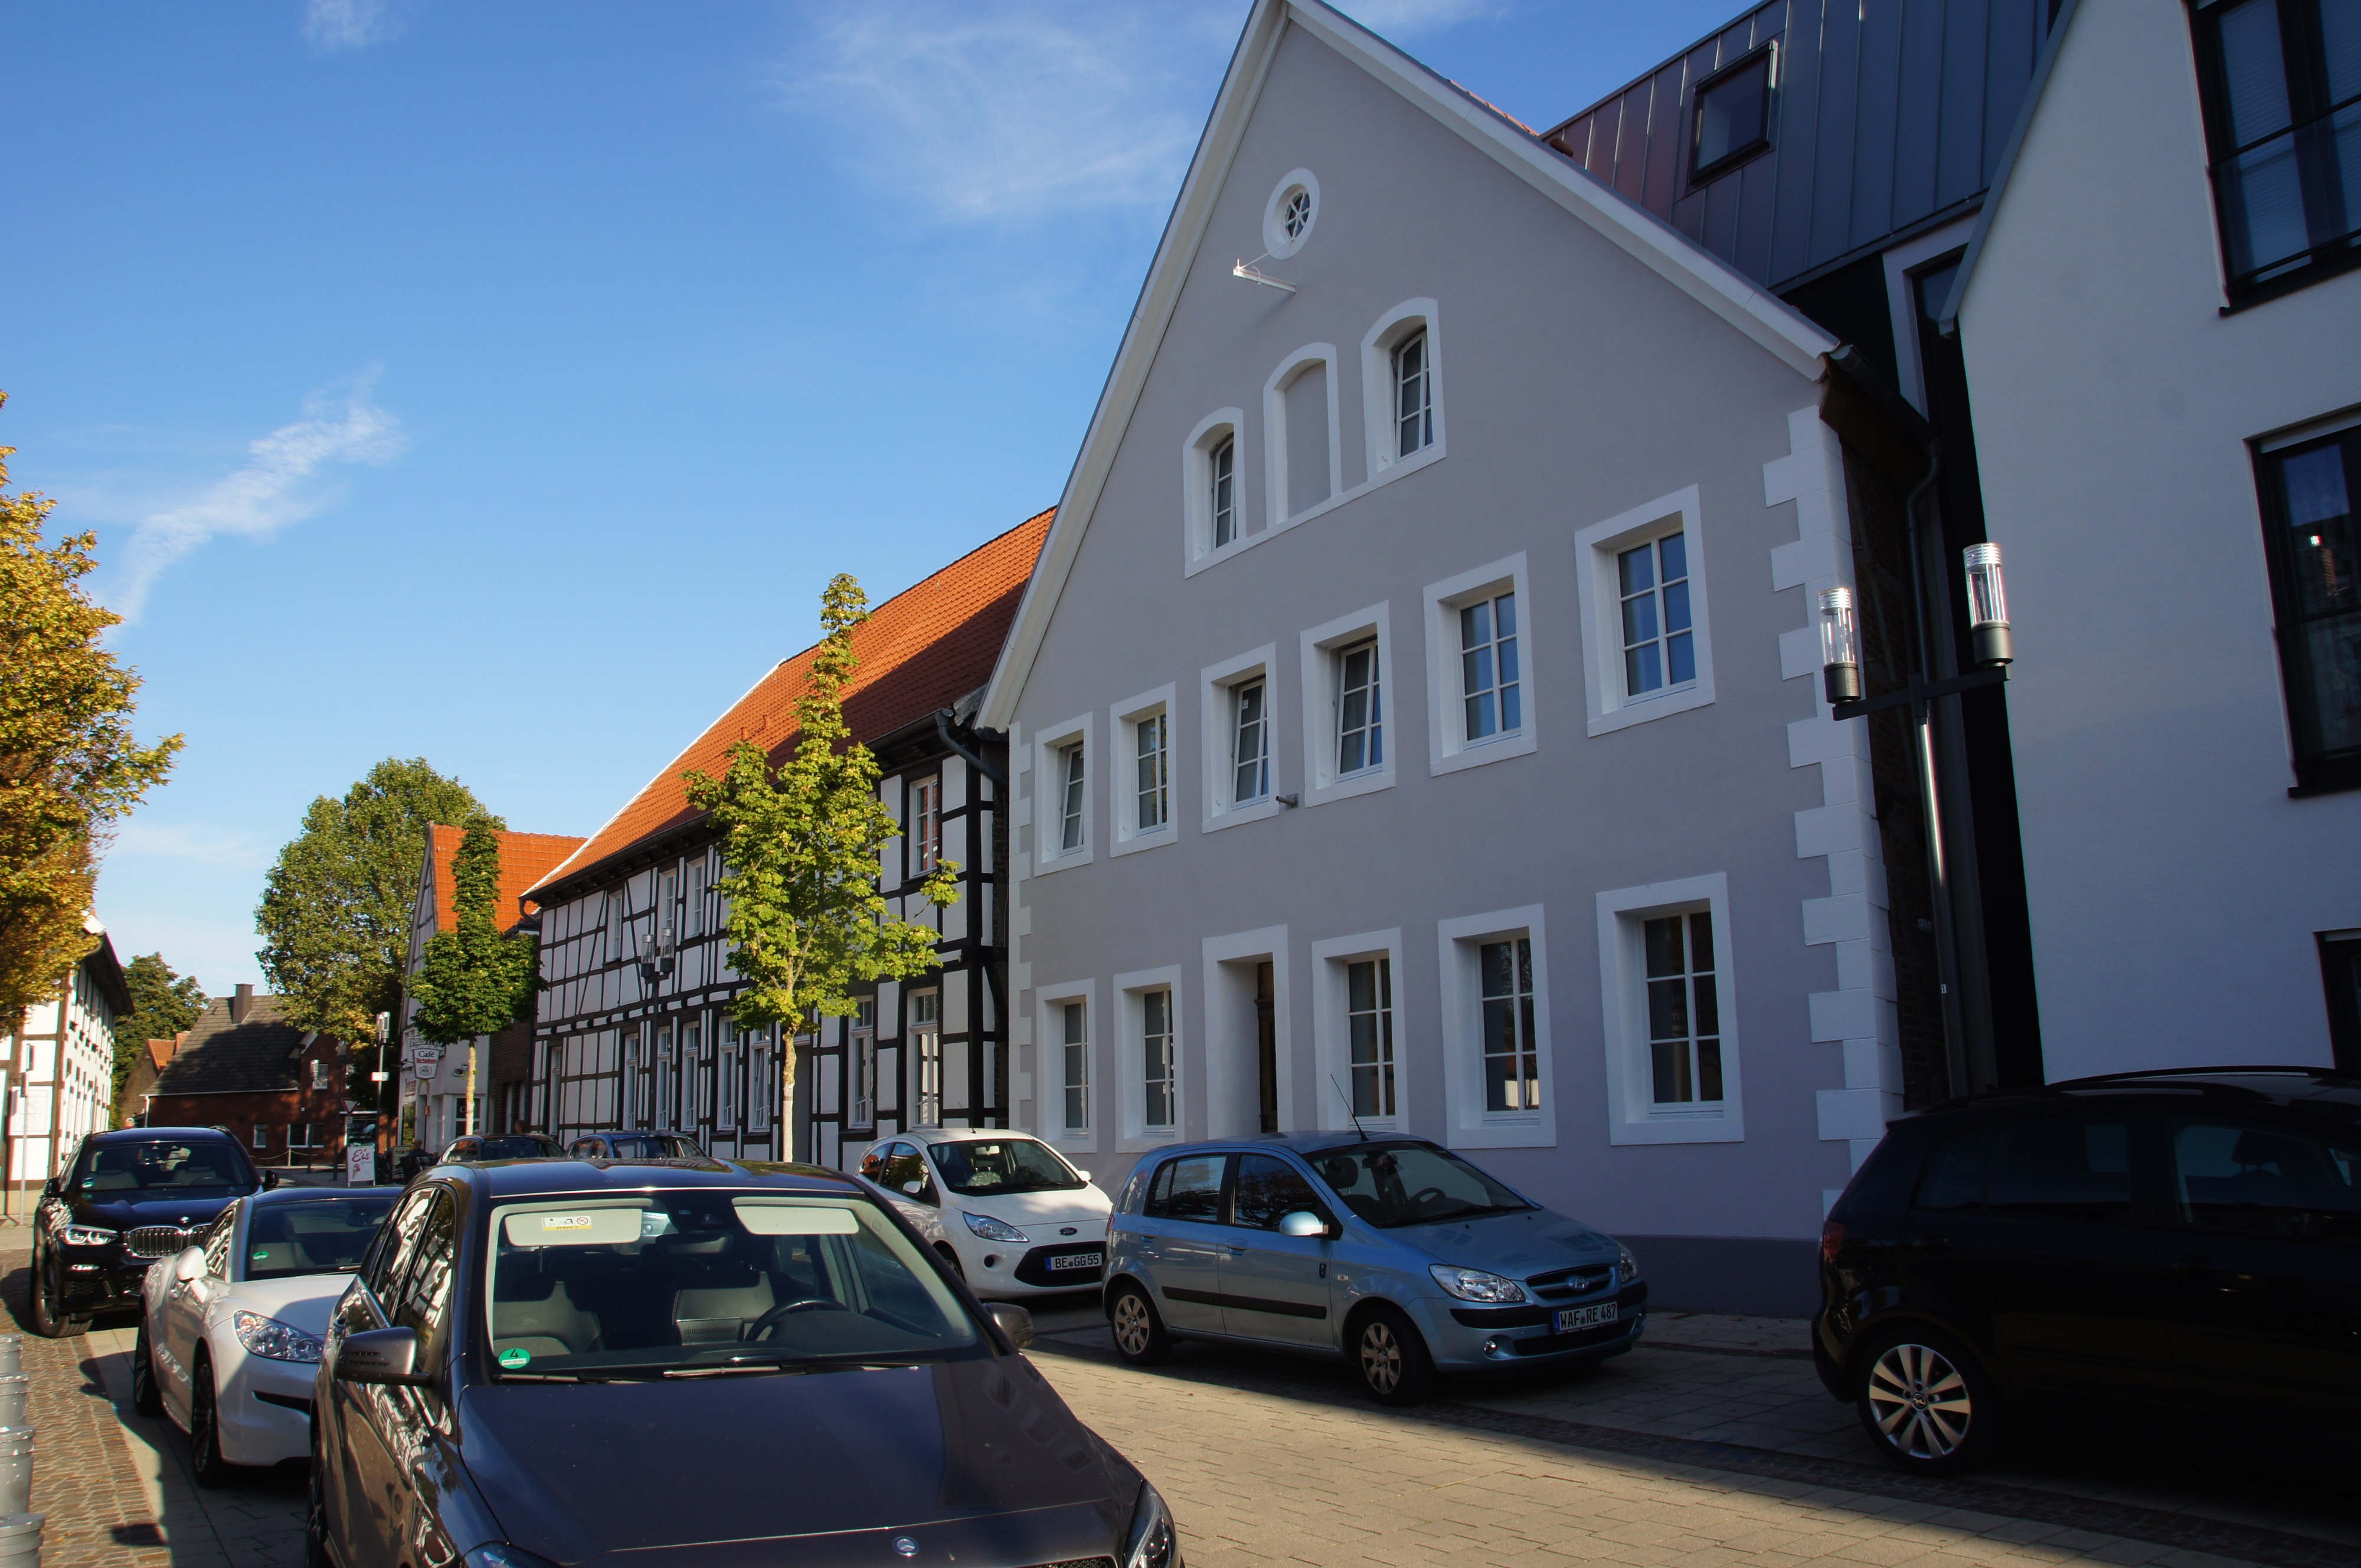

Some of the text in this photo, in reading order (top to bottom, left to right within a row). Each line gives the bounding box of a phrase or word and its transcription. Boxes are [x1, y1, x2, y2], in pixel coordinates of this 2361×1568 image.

[352, 1149, 370, 1163] Eis
[1055, 1254, 1099, 1269] BE GG 55
[1560, 1303, 1616, 1328] WAF RE 487
[510, 1349, 519, 1358] 4
